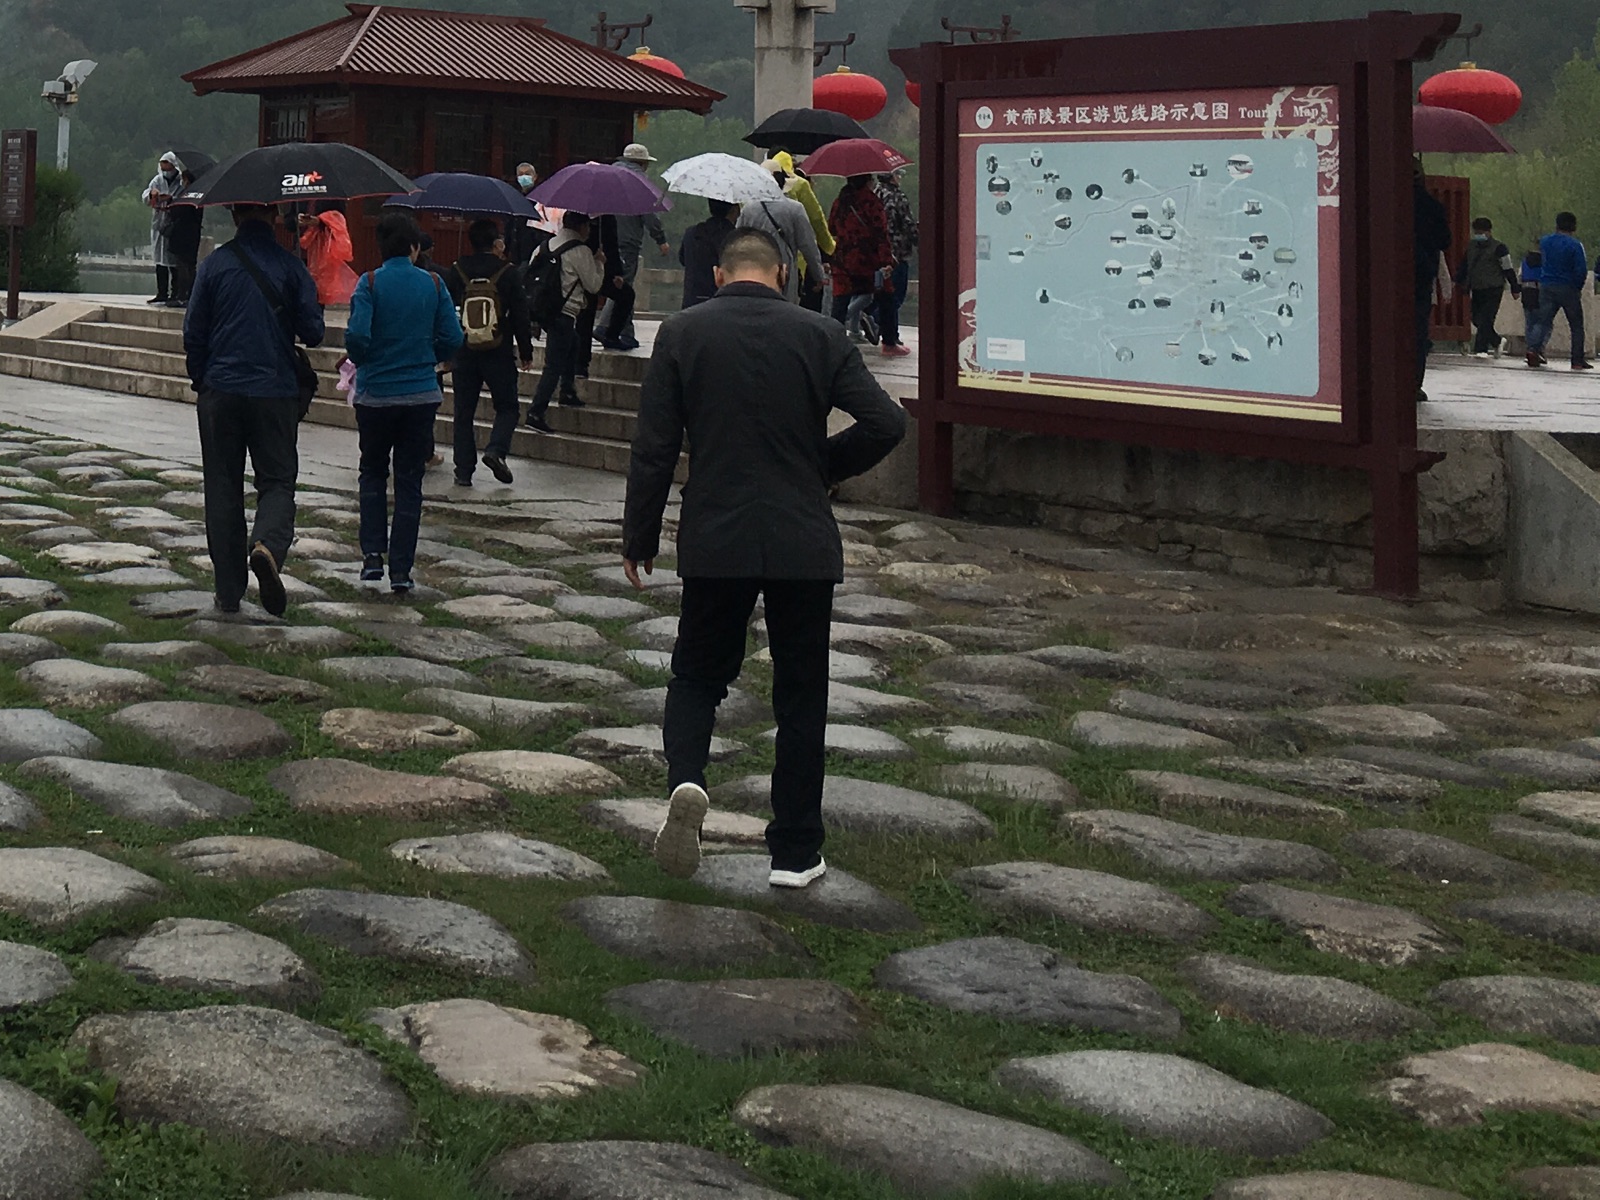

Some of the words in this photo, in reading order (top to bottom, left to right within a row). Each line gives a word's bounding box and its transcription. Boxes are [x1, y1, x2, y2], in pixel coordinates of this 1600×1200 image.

[1003, 102, 1229, 126] 黄帝陵景区游览线路示意图
[1293, 105, 1319, 119] Map
